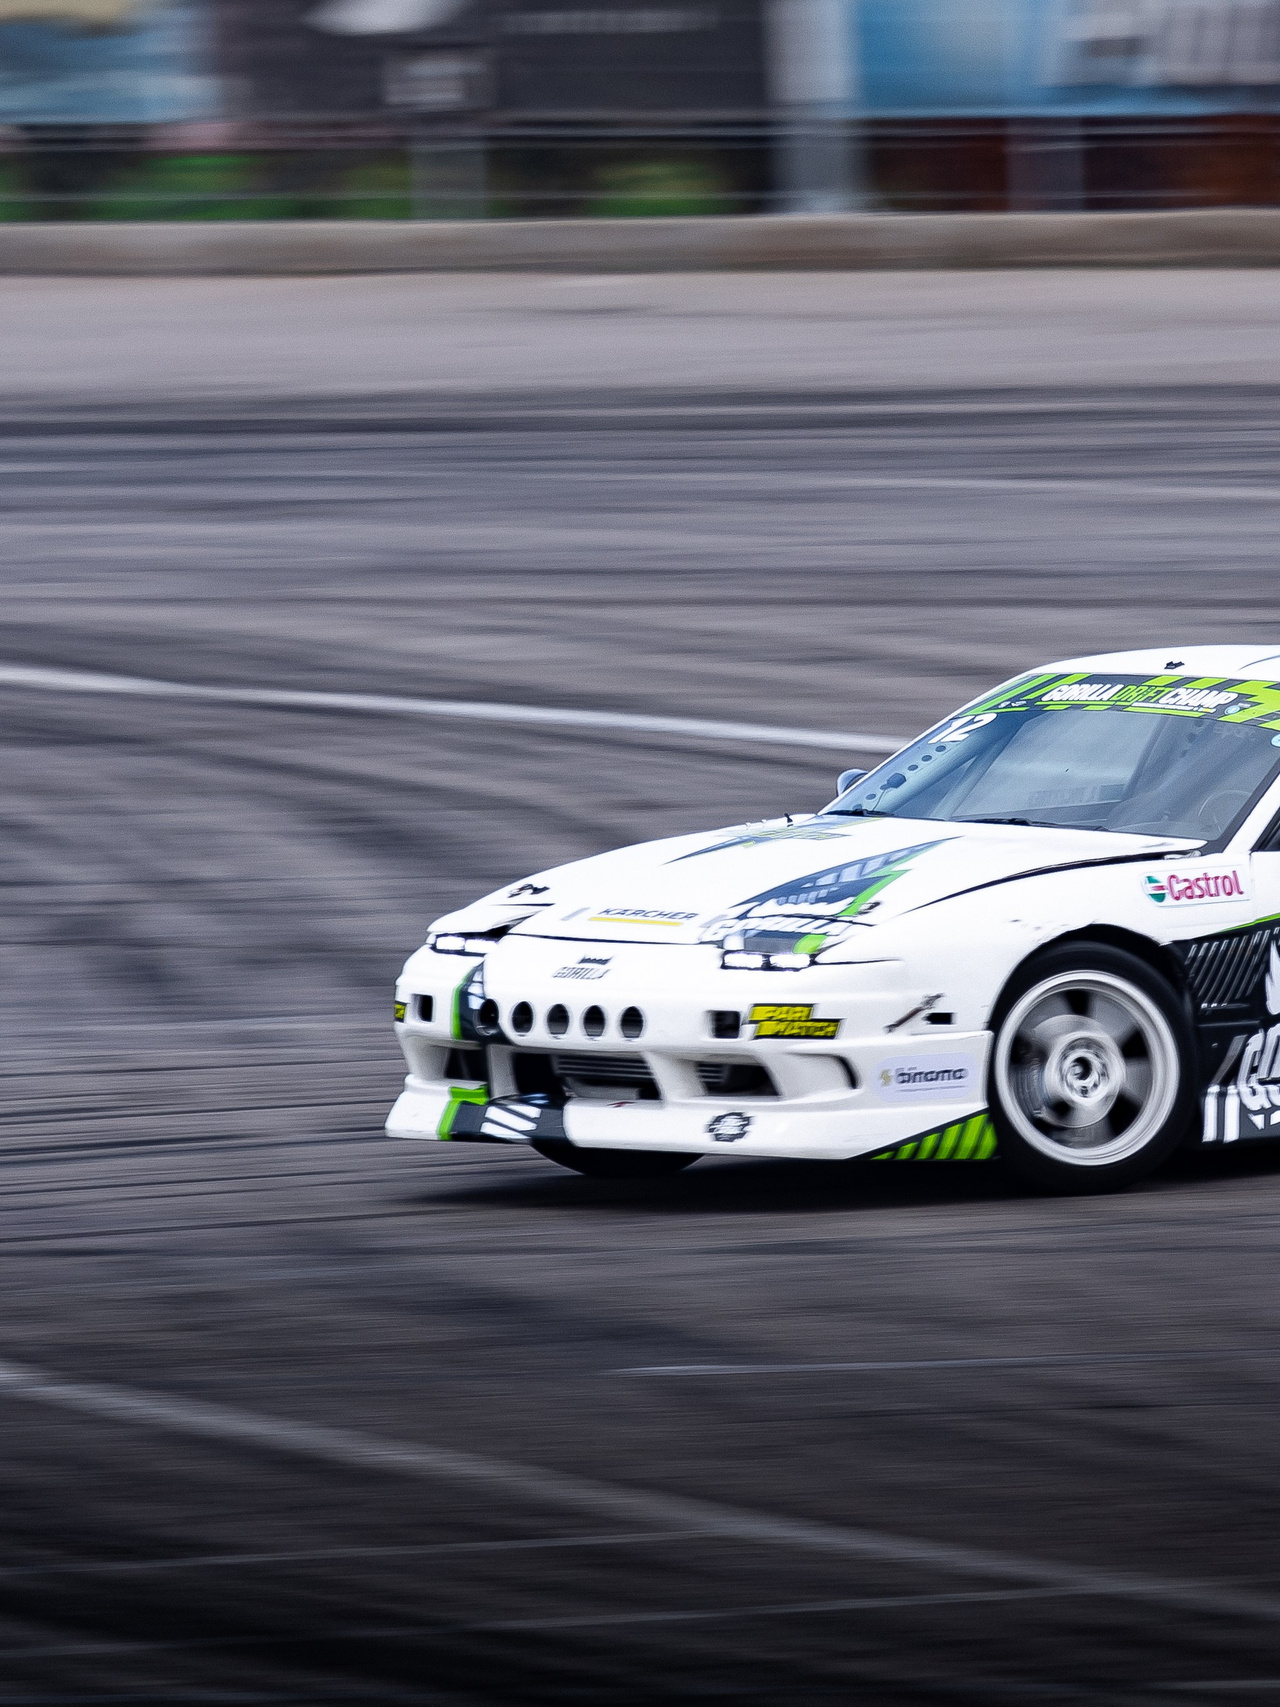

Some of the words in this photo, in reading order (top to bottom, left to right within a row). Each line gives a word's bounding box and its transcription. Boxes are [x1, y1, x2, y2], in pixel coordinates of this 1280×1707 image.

[1041, 684, 1124, 702] GORILLA
[1116, 685, 1177, 702] DRIFT
[1159, 687, 1239, 708] CHAMP
[928, 713, 998, 744] 12
[1167, 870, 1244, 901] Castrol
